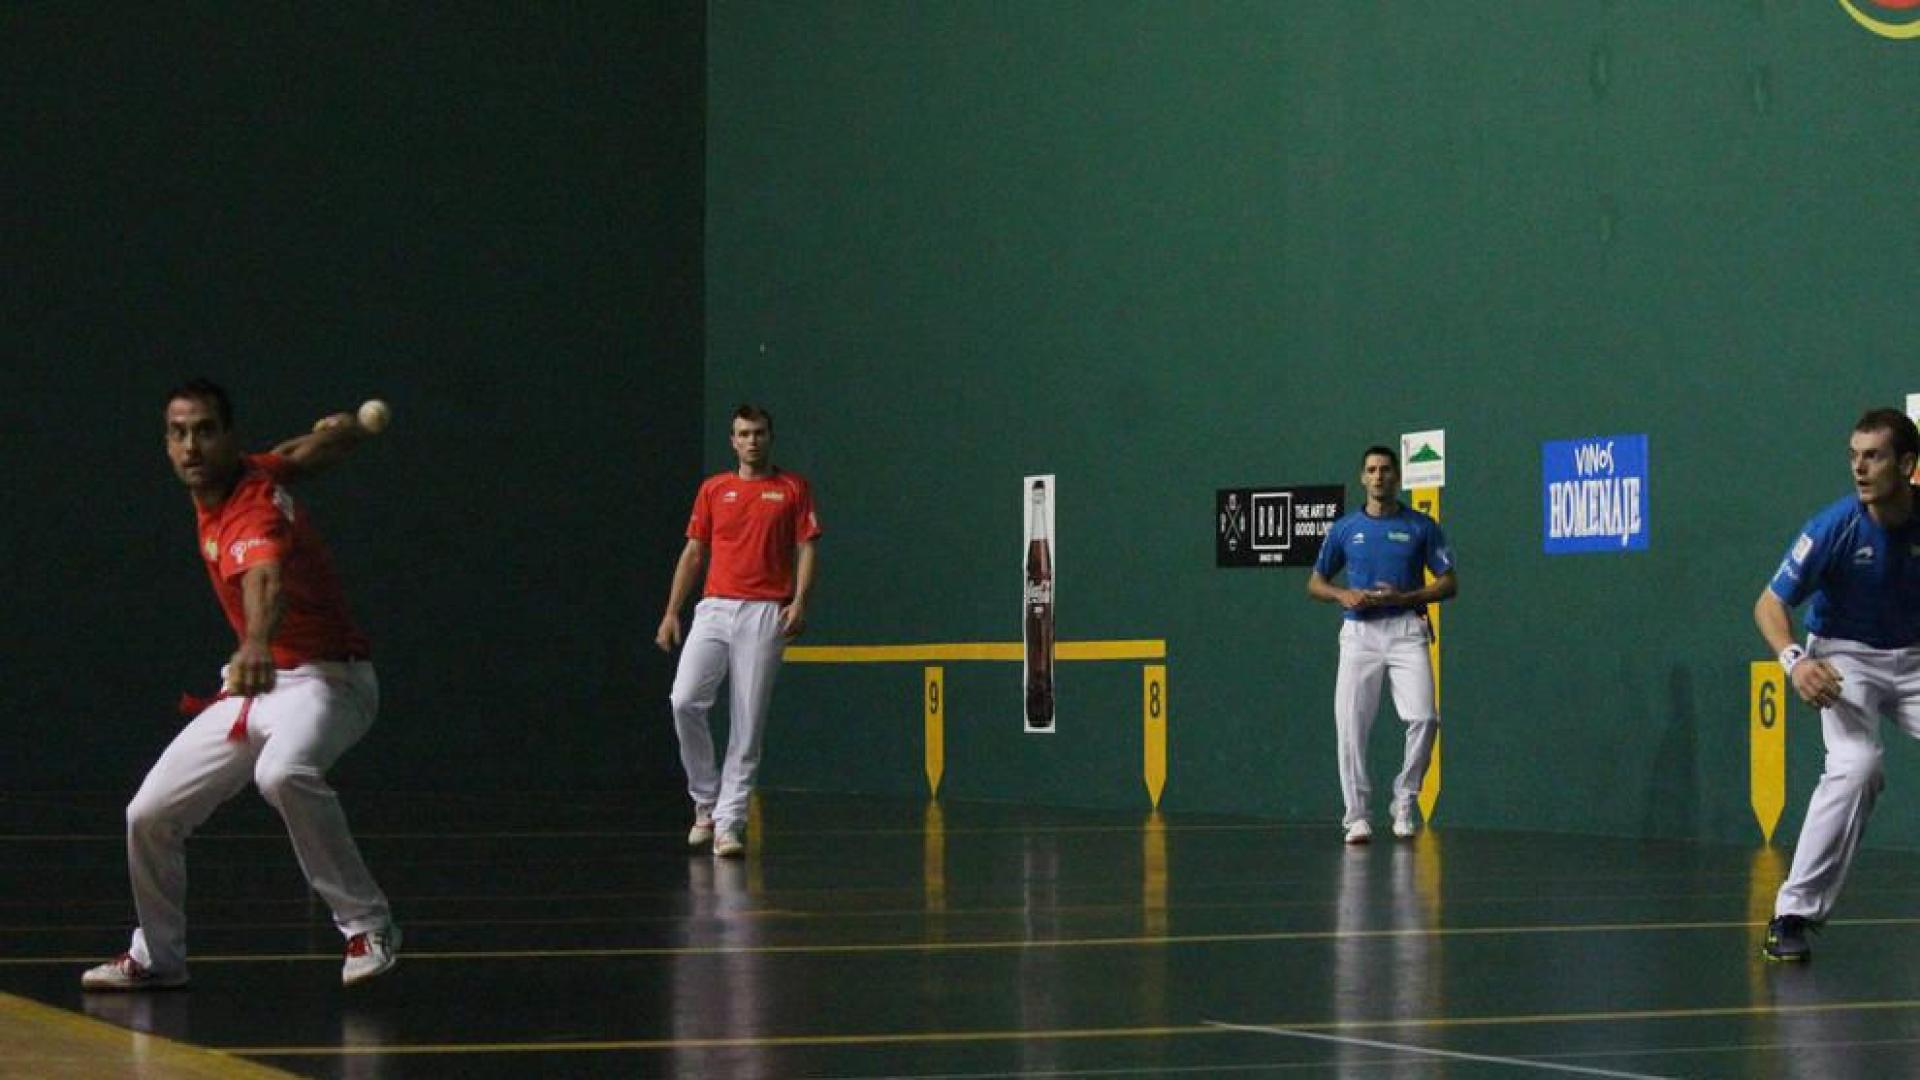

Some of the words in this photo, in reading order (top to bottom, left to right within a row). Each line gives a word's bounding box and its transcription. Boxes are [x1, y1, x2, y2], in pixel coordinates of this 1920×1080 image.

[1550, 477, 1641, 547] HOMENAJE
[928, 681, 939, 714] 9
[1149, 681, 1160, 718] 8
[1760, 681, 1776, 729] 6
